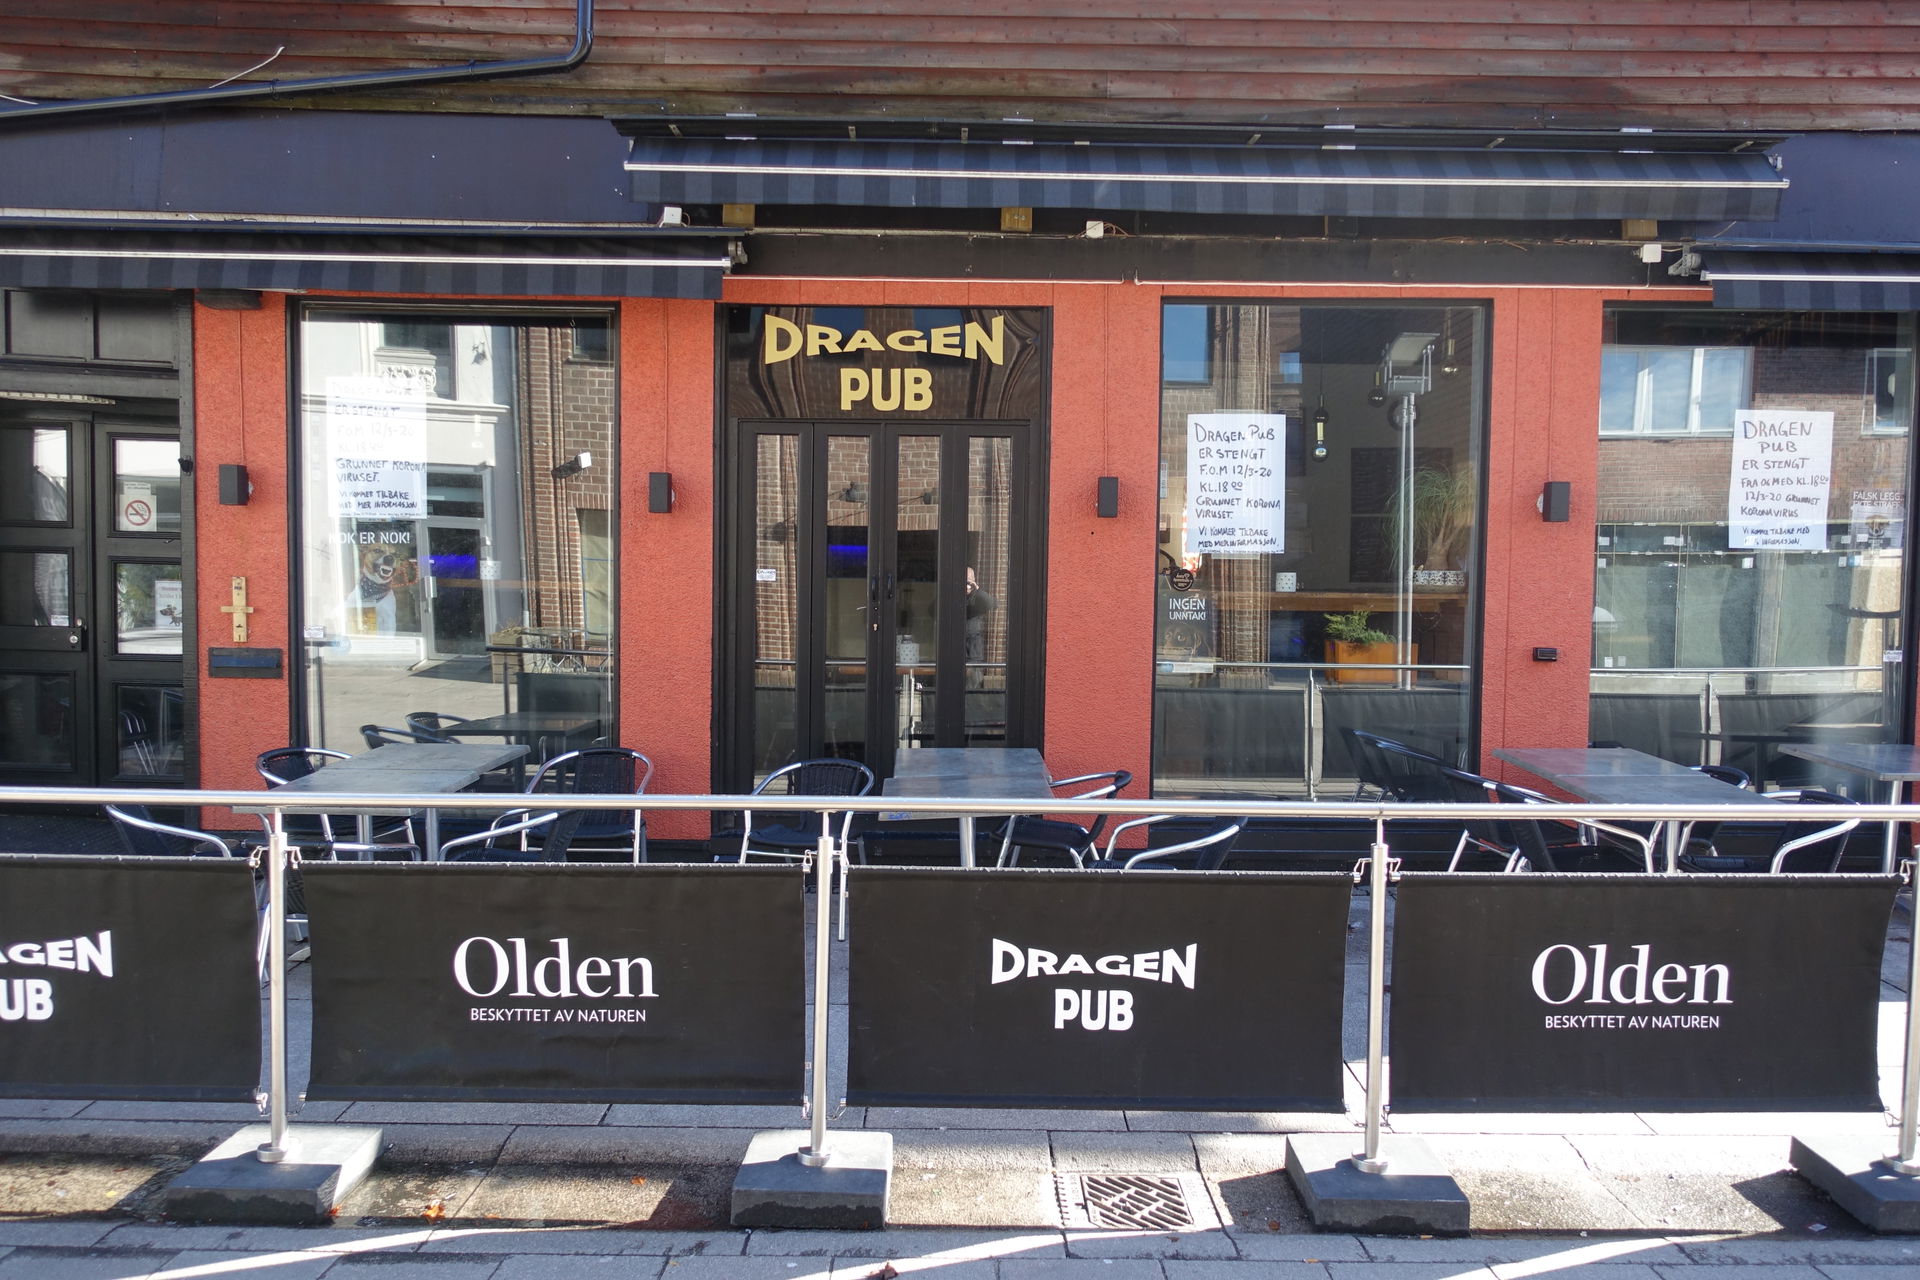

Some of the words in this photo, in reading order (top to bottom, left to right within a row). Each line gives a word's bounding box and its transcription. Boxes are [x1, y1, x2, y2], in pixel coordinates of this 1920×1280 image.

[765, 314, 1004, 366] DRAGEN
[840, 368, 933, 411] PUB
[1194, 423, 1246, 443] DRAGEN
[1743, 421, 1813, 439] DRAGEN
[1199, 447, 1213, 459] ER
[1216, 448, 1266, 460] STENGT
[1758, 441, 1797, 454] PUB
[336, 458, 388, 469] GRUNNET
[1742, 460, 1759, 470] ER
[1764, 458, 1810, 470] STENGT
[1232, 464, 1272, 479] 12/3-20
[1741, 477, 1758, 488] FRA
[1772, 477, 1793, 486] MED
[376, 490, 409, 500] TILBAKE
[1745, 491, 1782, 501] 12/3-20
[1853, 491, 1878, 500] FALSK
[1196, 496, 1241, 507] GRUNNET
[1246, 498, 1280, 510] KORONA
[360, 532, 375, 544] ER
[381, 532, 410, 544] NOK!
[1169, 599, 1205, 610] INGEN
[1169, 611, 1206, 621] UNNTAK!
[0, 930, 113, 978] GEN
[453, 936, 660, 998] Olden
[991, 938, 1197, 989] DRAGEN
[1531, 943, 1734, 1004] Olden
[470, 1007, 551, 1022] BESKYTTET
[554, 1009, 574, 1022] AV
[578, 1009, 646, 1023] NATUREN
[1054, 988, 1134, 1031] PUB
[1545, 1015, 1625, 1029] BESKYTTET
[1628, 1016, 1648, 1029] AV
[1652, 1015, 1720, 1029] NATUREN
